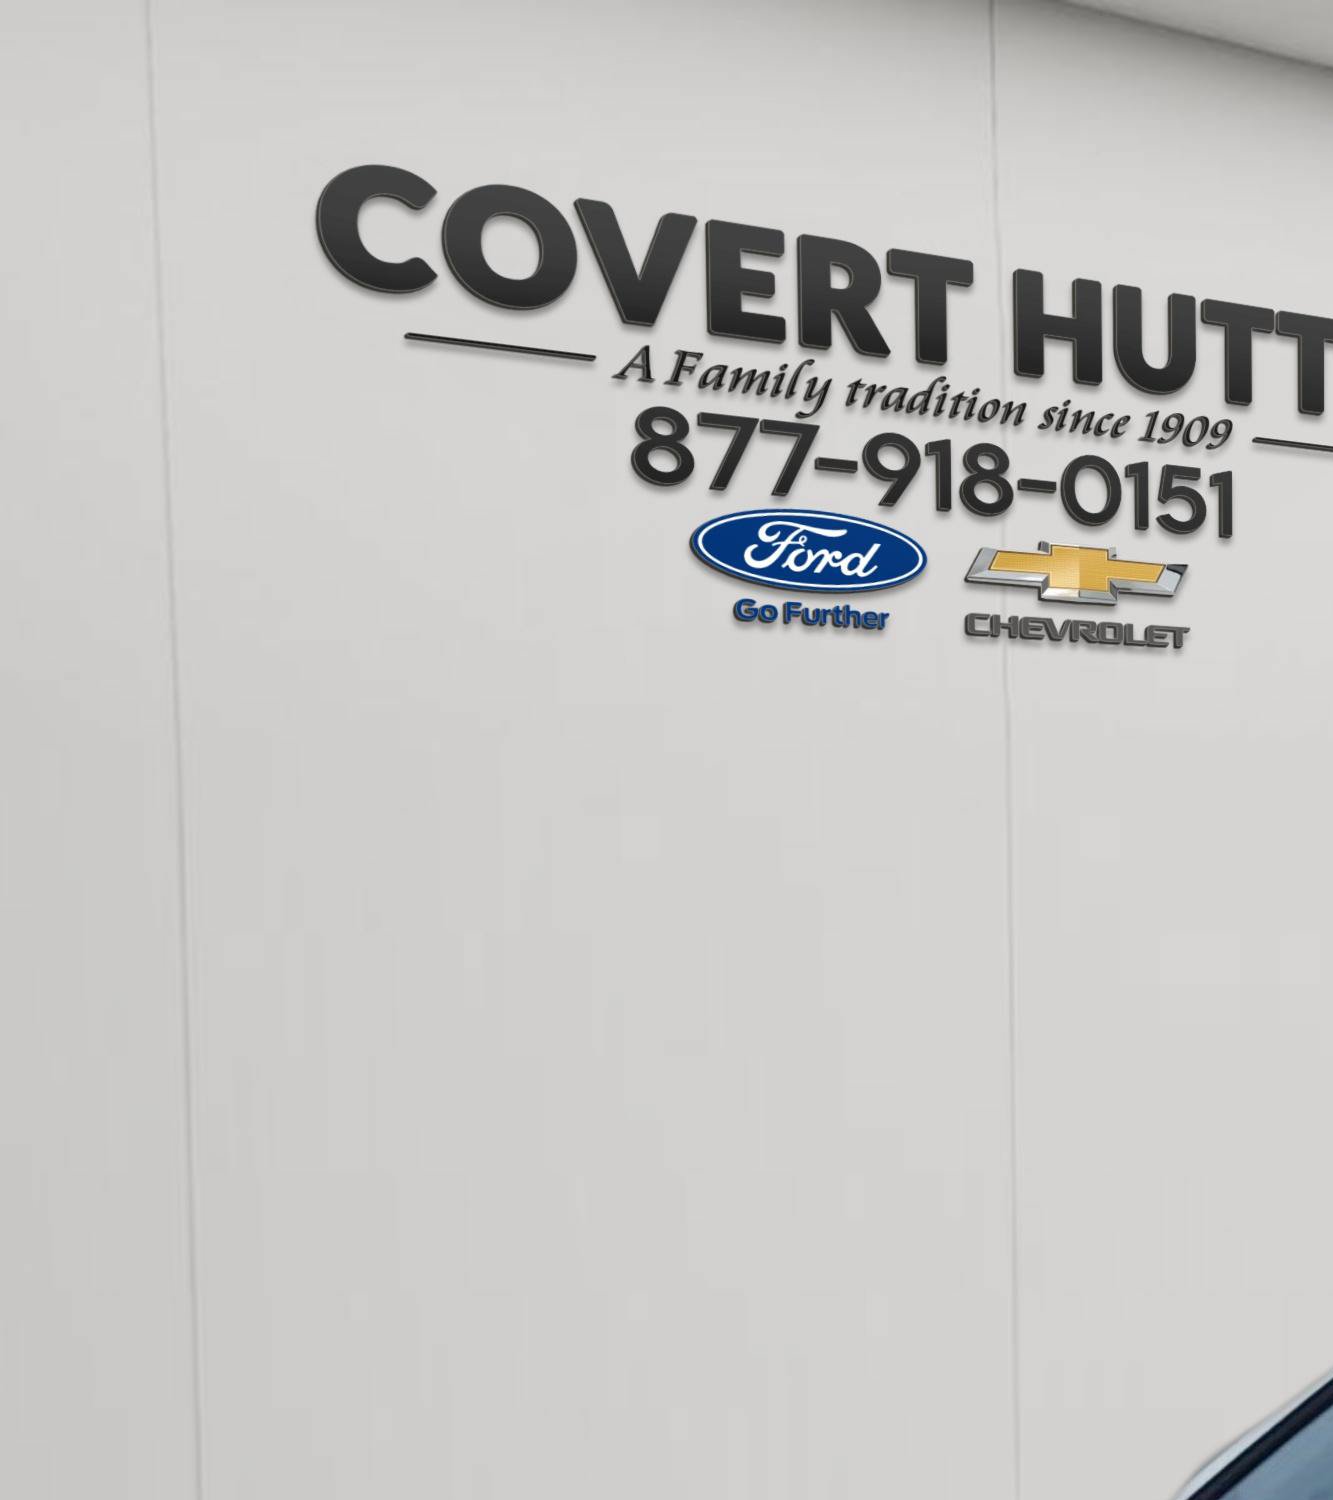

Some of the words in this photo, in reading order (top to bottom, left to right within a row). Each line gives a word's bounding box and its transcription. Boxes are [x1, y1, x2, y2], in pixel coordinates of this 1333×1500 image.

[315, 163, 974, 364] COVERT
[612, 344, 653, 382] A
[665, 351, 832, 419] Family
[844, 376, 1025, 430] tradition
[1038, 402, 1128, 439] since
[1143, 410, 1234, 450] 1909
[630, 406, 1234, 539] 877-918-0151
[743, 521, 880, 579] Ford
[733, 598, 779, 624] Go
[783, 602, 889, 629] Further
[964, 613, 1191, 649] CHEVROLET
